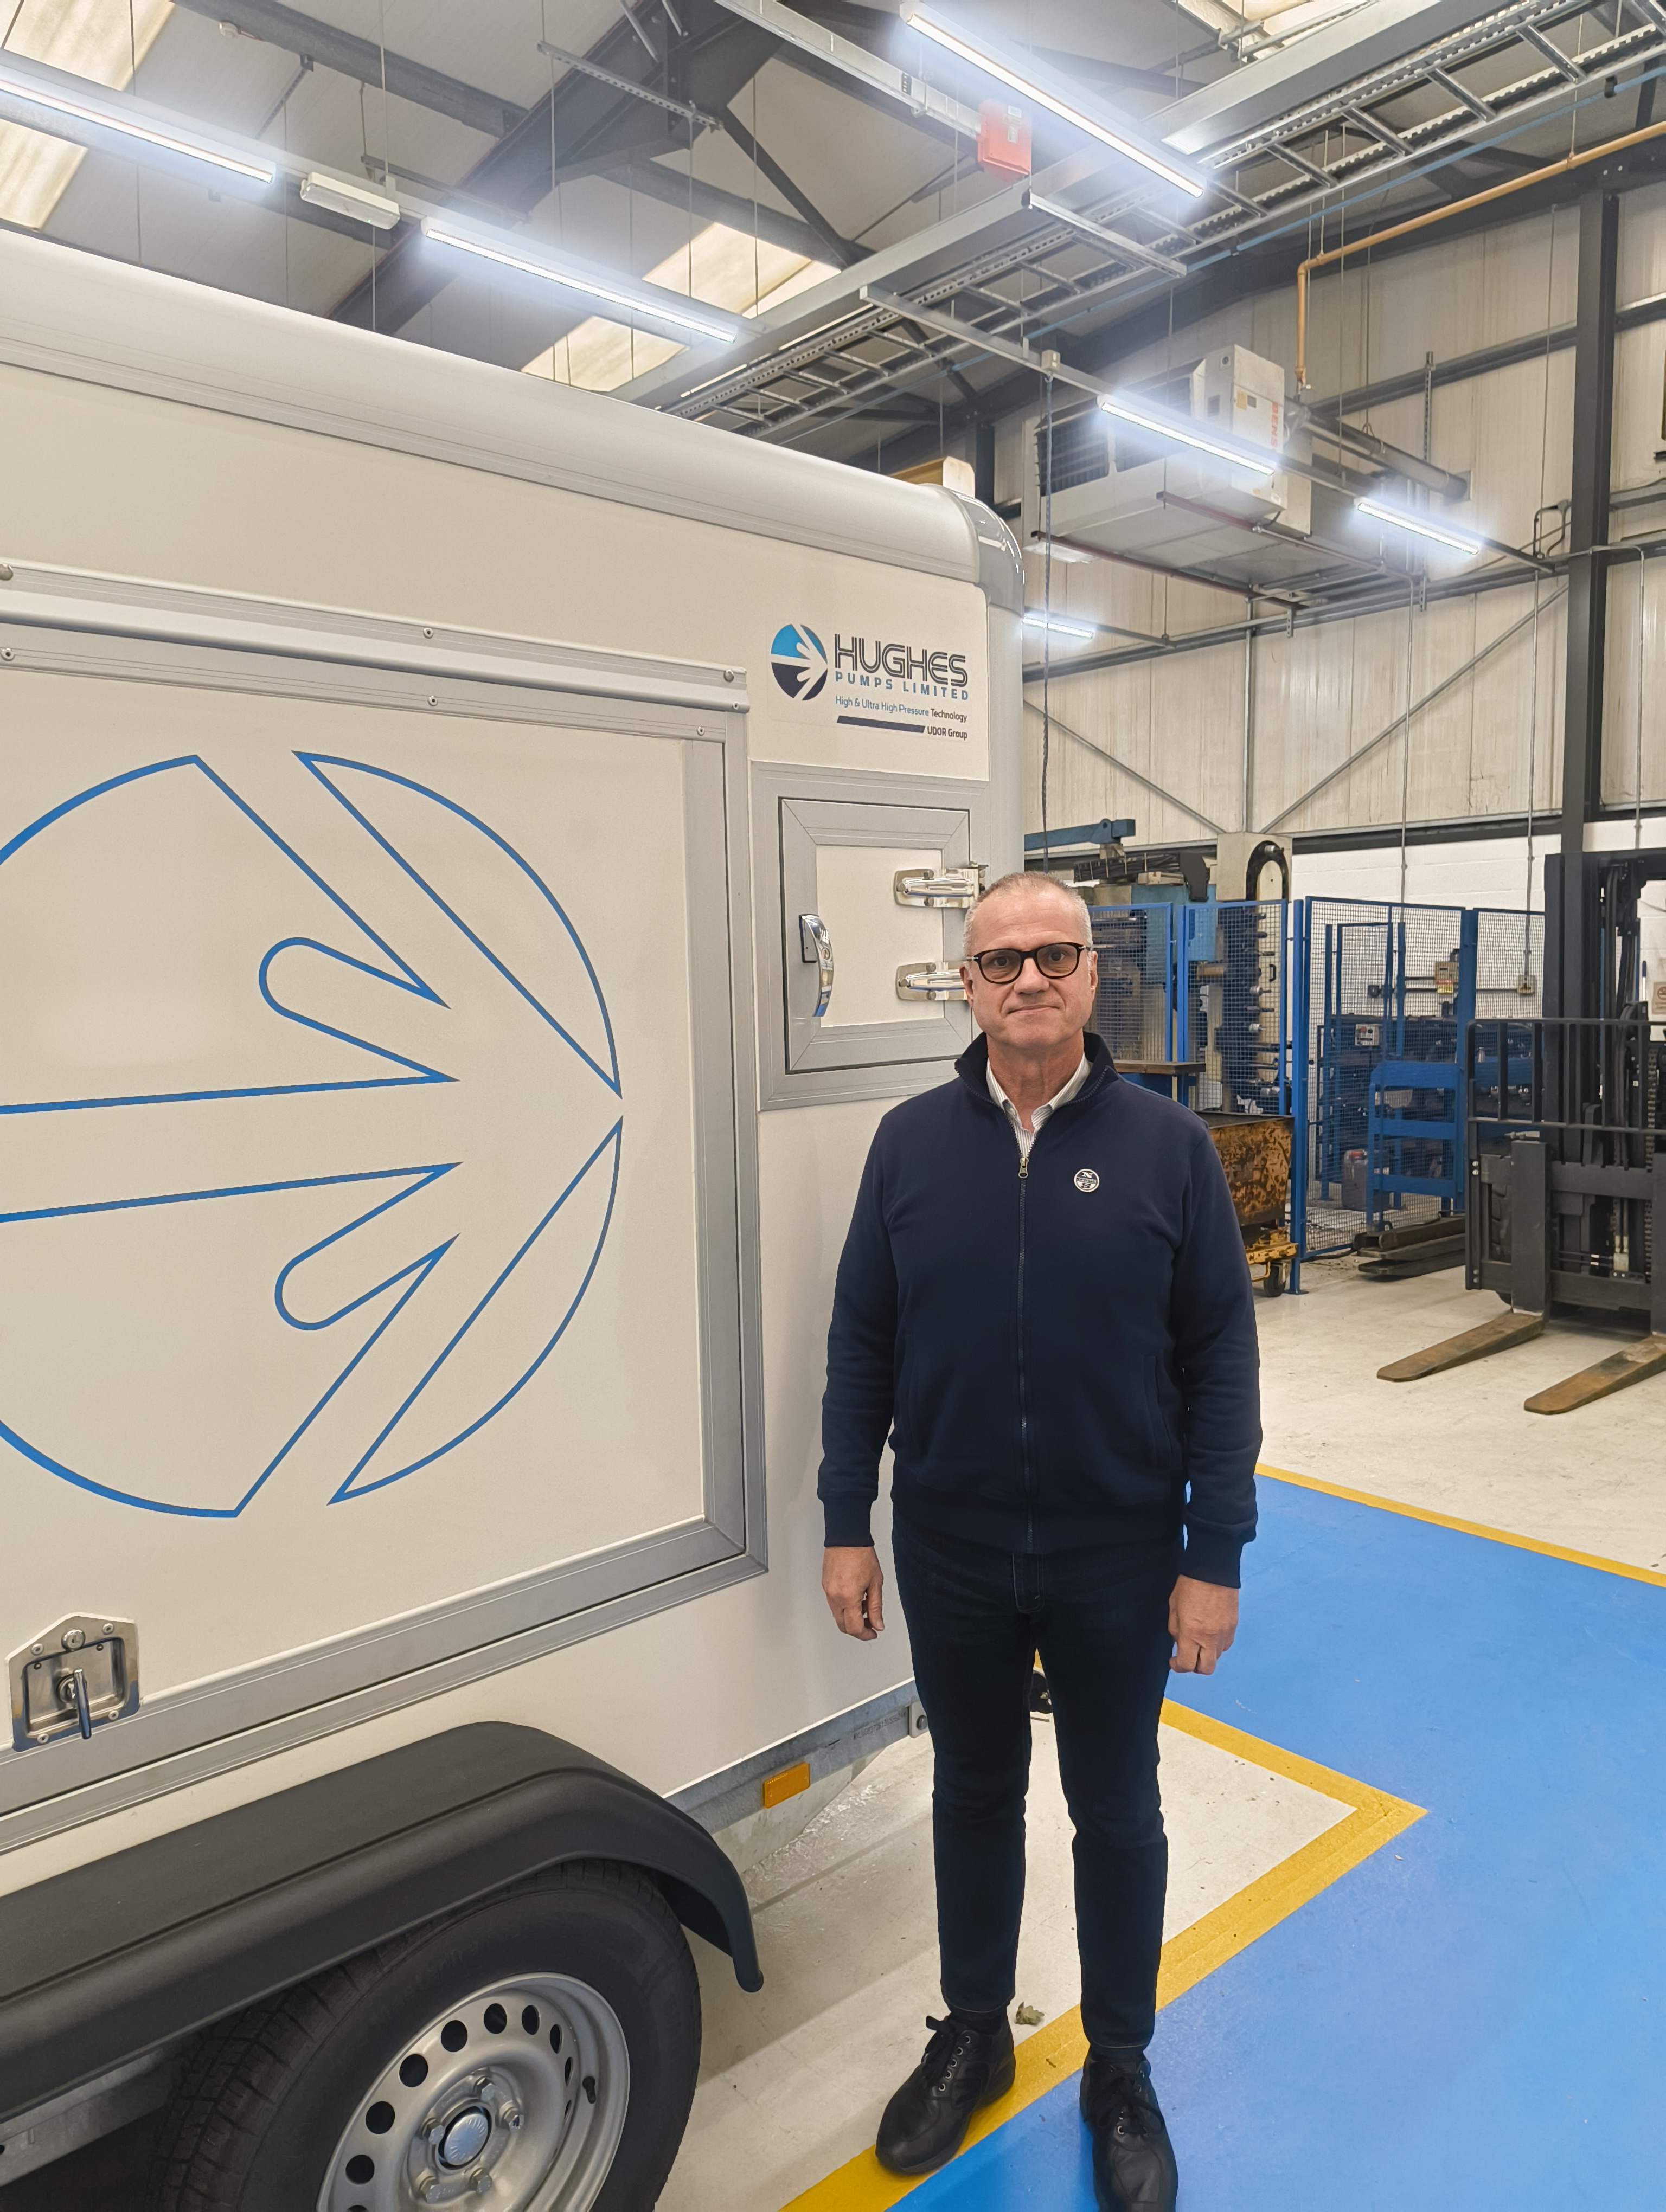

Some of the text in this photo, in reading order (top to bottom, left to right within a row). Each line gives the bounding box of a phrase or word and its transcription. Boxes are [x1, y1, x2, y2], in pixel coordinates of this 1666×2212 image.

[834, 633, 968, 687] HUGHES
[835, 671, 969, 700] PUMPS LIMITED
[835, 695, 967, 723] High & Ultra High Pressure Technology
[927, 726, 968, 741] UDOR Group
